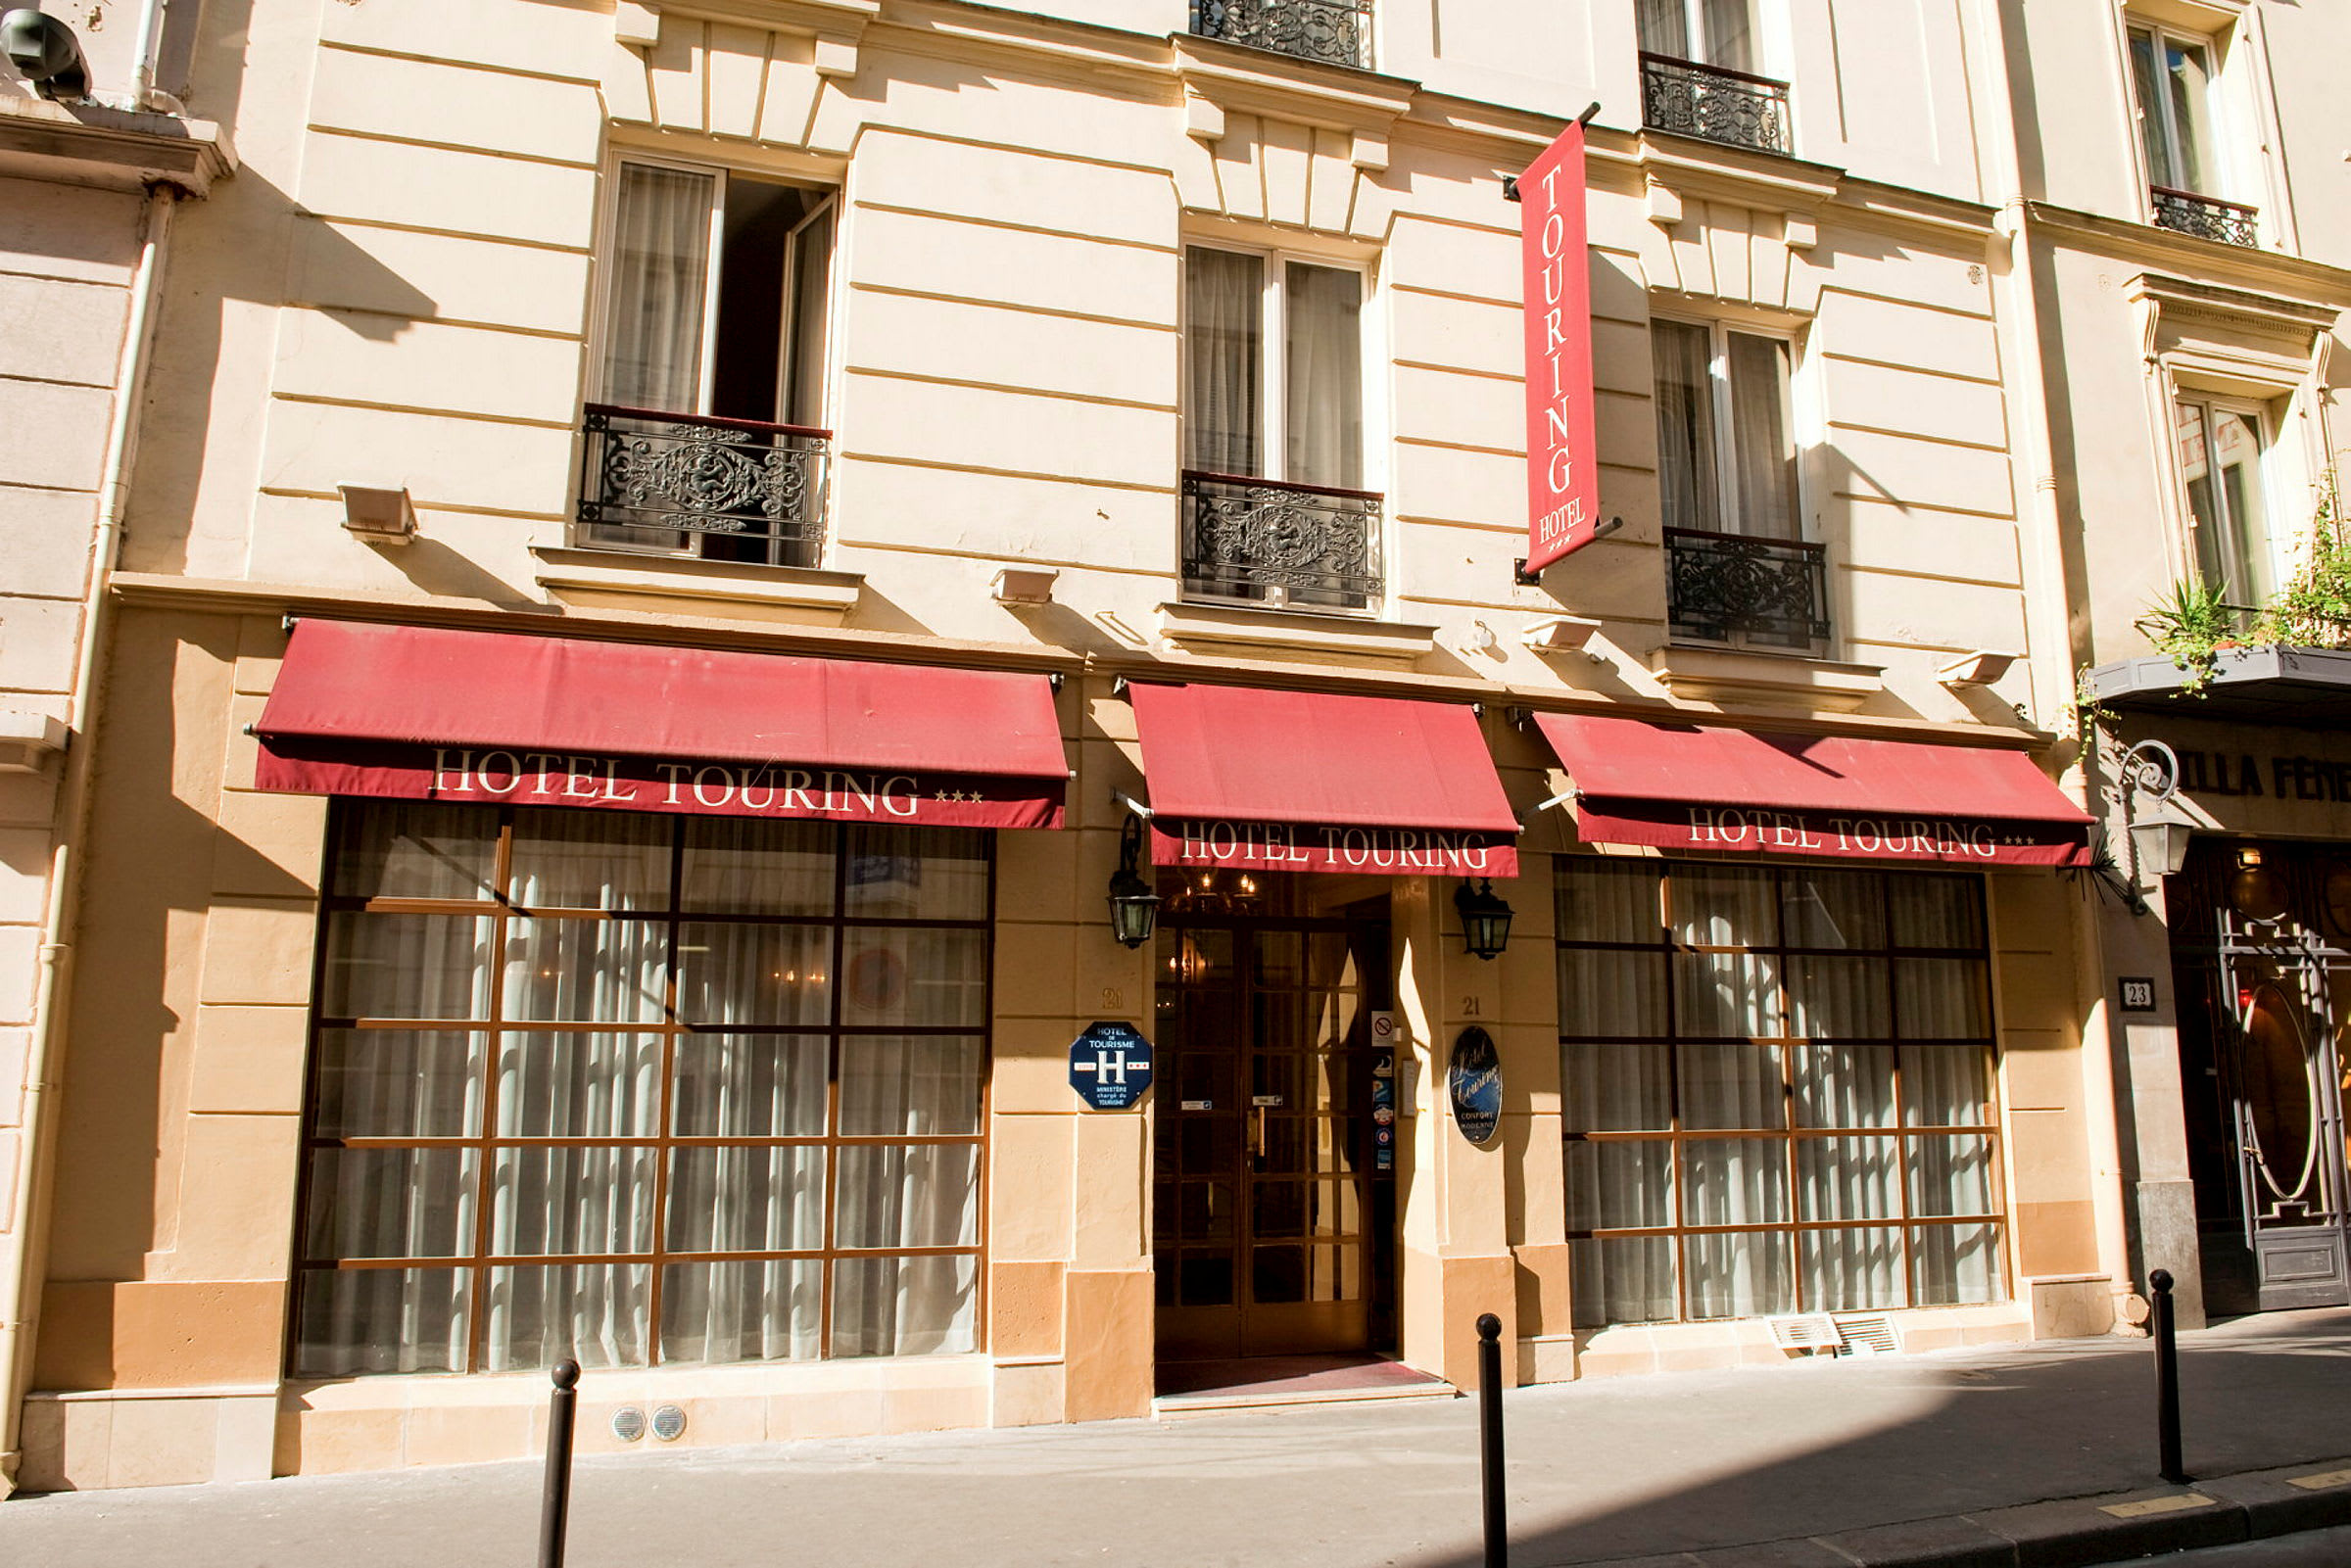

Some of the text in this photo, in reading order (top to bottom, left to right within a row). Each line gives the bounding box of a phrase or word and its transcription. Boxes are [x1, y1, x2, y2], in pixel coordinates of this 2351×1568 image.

[1541, 164, 1572, 494] TOURING
[1539, 498, 1586, 546] HOTEL
[427, 747, 919, 817] HOTEL TOURING
[1180, 821, 1489, 870] HOTEL TOURING
[1687, 807, 1996, 857] HOTEL TOURING
[1463, 996, 1481, 1016] 21
[2128, 985, 2147, 1003] 23
[1089, 1040, 1135, 1049] TOURISME
[1097, 1026, 1128, 1036] HOTEL
[1097, 1050, 1127, 1084] H
